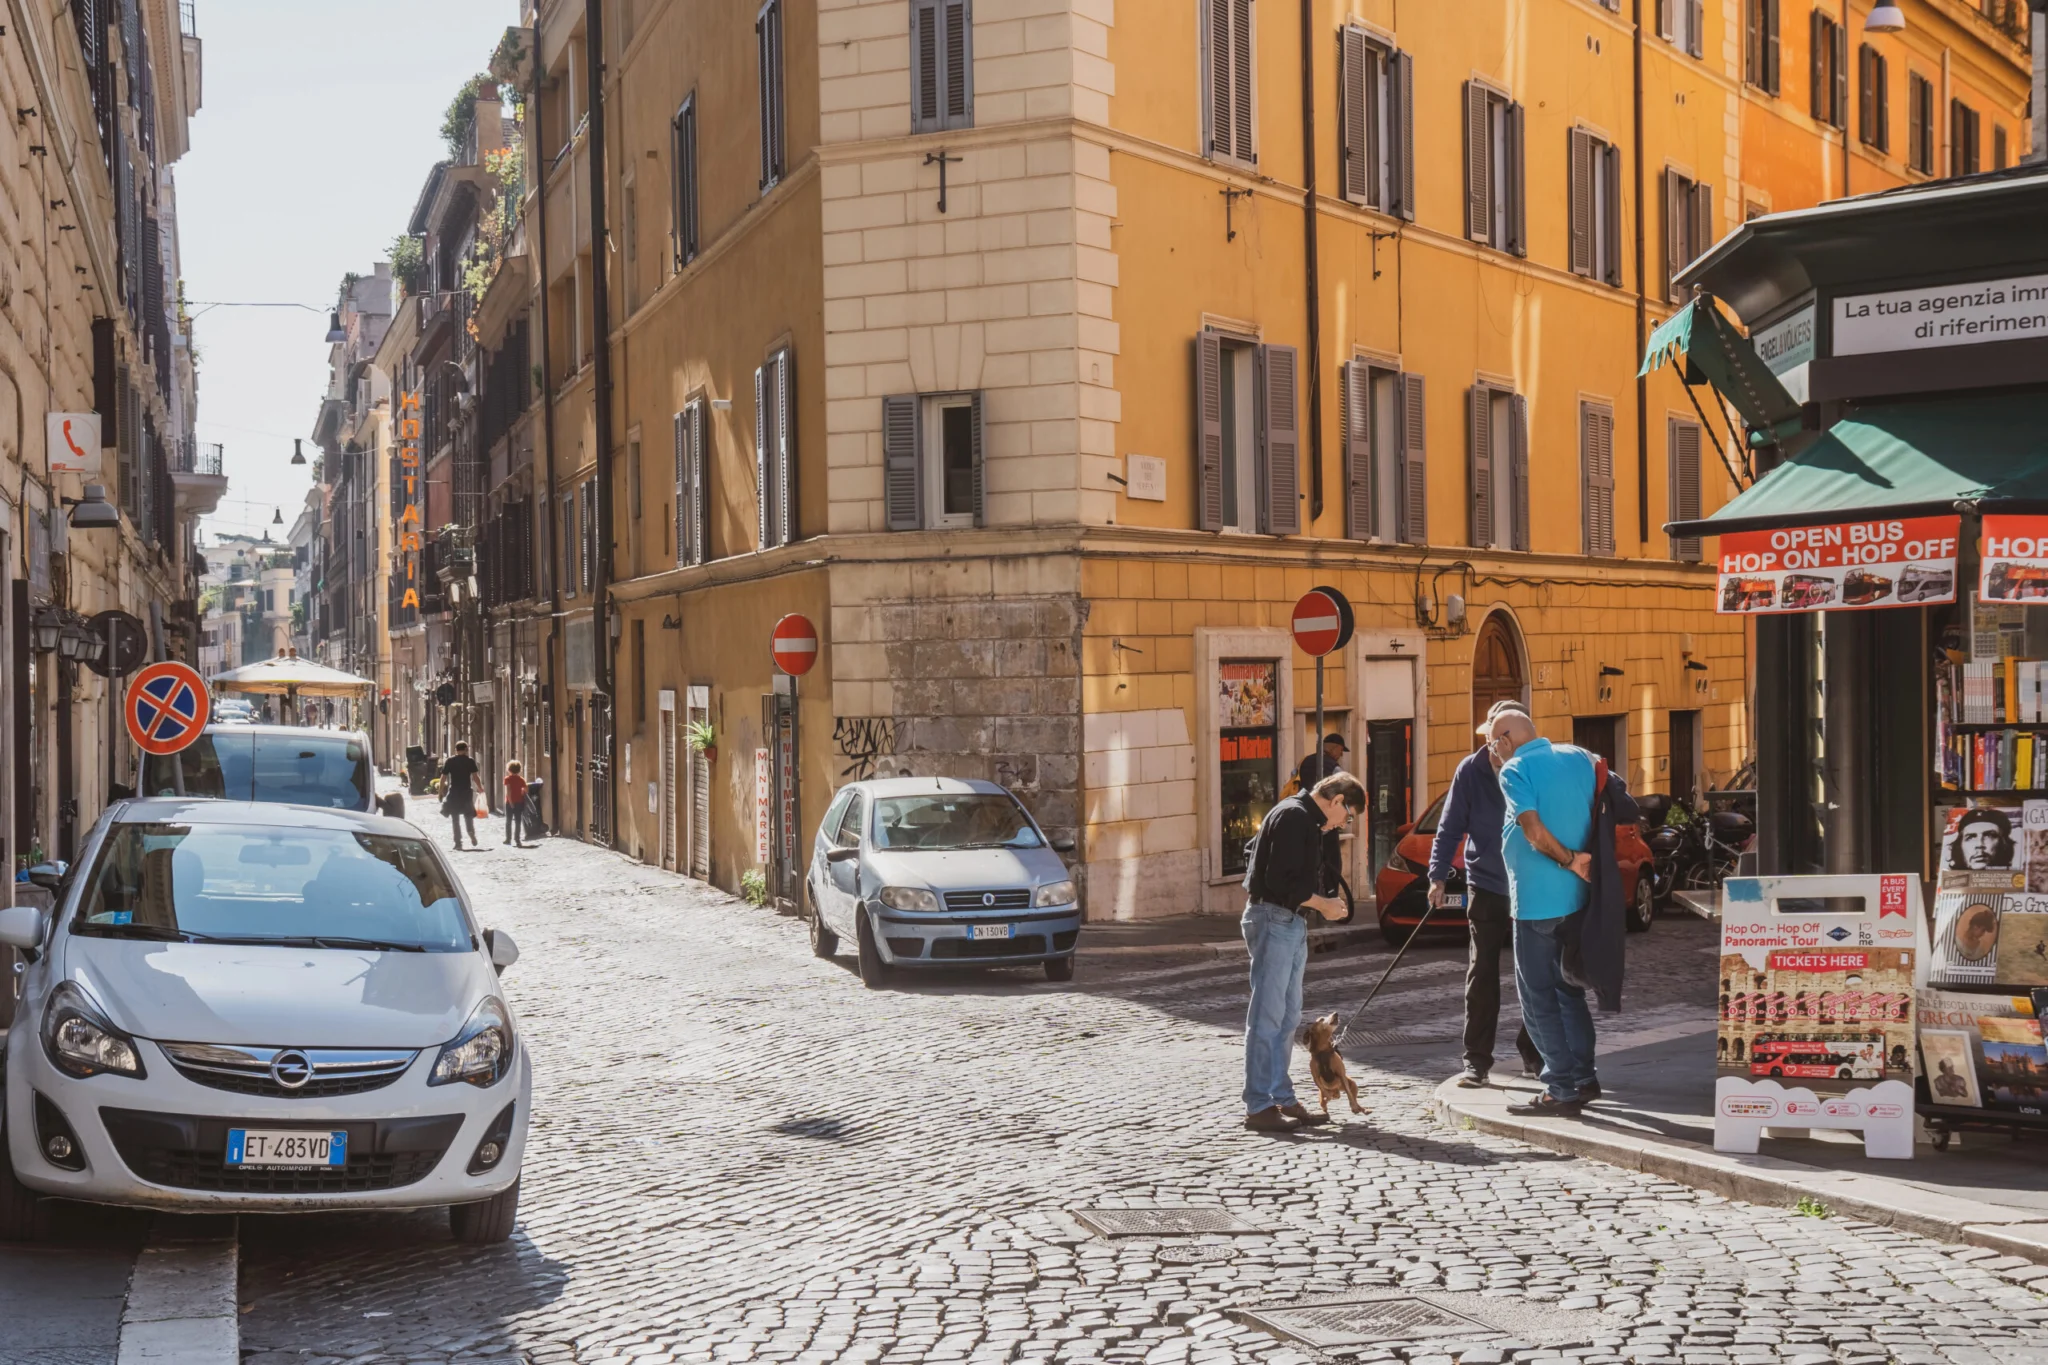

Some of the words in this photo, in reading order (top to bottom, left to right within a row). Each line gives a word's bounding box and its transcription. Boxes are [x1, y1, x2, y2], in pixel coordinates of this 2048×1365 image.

[1845, 302, 1870, 318] La
[1876, 300, 1912, 316] tua
[1918, 288, 2005, 313] agenzia
[2012, 285, 2048, 303] im
[1914, 320, 1933, 338] di
[1940, 314, 2048, 337] riferimen
[401, 390, 420, 609] HOSTARIA
[1771, 526, 1842, 550] OPEN
[1850, 521, 1904, 544] BUS
[1723, 552, 1777, 573] HOP
[1783, 548, 1820, 569] ON
[1842, 543, 1897, 565] HOP
[1904, 538, 1956, 559] OFF
[757, 752, 768, 863] MINIMARKET
[783, 742, 792, 859] MINIMARKET
[1885, 892, 1901, 905] 15
[2003, 896, 2023, 912] De
[974, 927, 983, 937] CN
[986, 926, 1008, 937] 130VB
[1725, 924, 1748, 936] Hop
[1750, 923, 1766, 934] On
[1777, 923, 1800, 935] Hop
[1803, 922, 1820, 933] Off
[1725, 936, 1788, 947] Panoramic
[1791, 935, 1819, 946] Tour
[1774, 955, 1827, 967] TICKETS
[1830, 955, 1864, 967] HERE
[1933, 999, 1968, 1010] EPISODI
[1917, 1010, 1976, 1026] GRECIA
[2019, 1105, 2041, 1115] Loira
[245, 1136, 268, 1157] ET
[274, 1137, 329, 1158] 483VD
